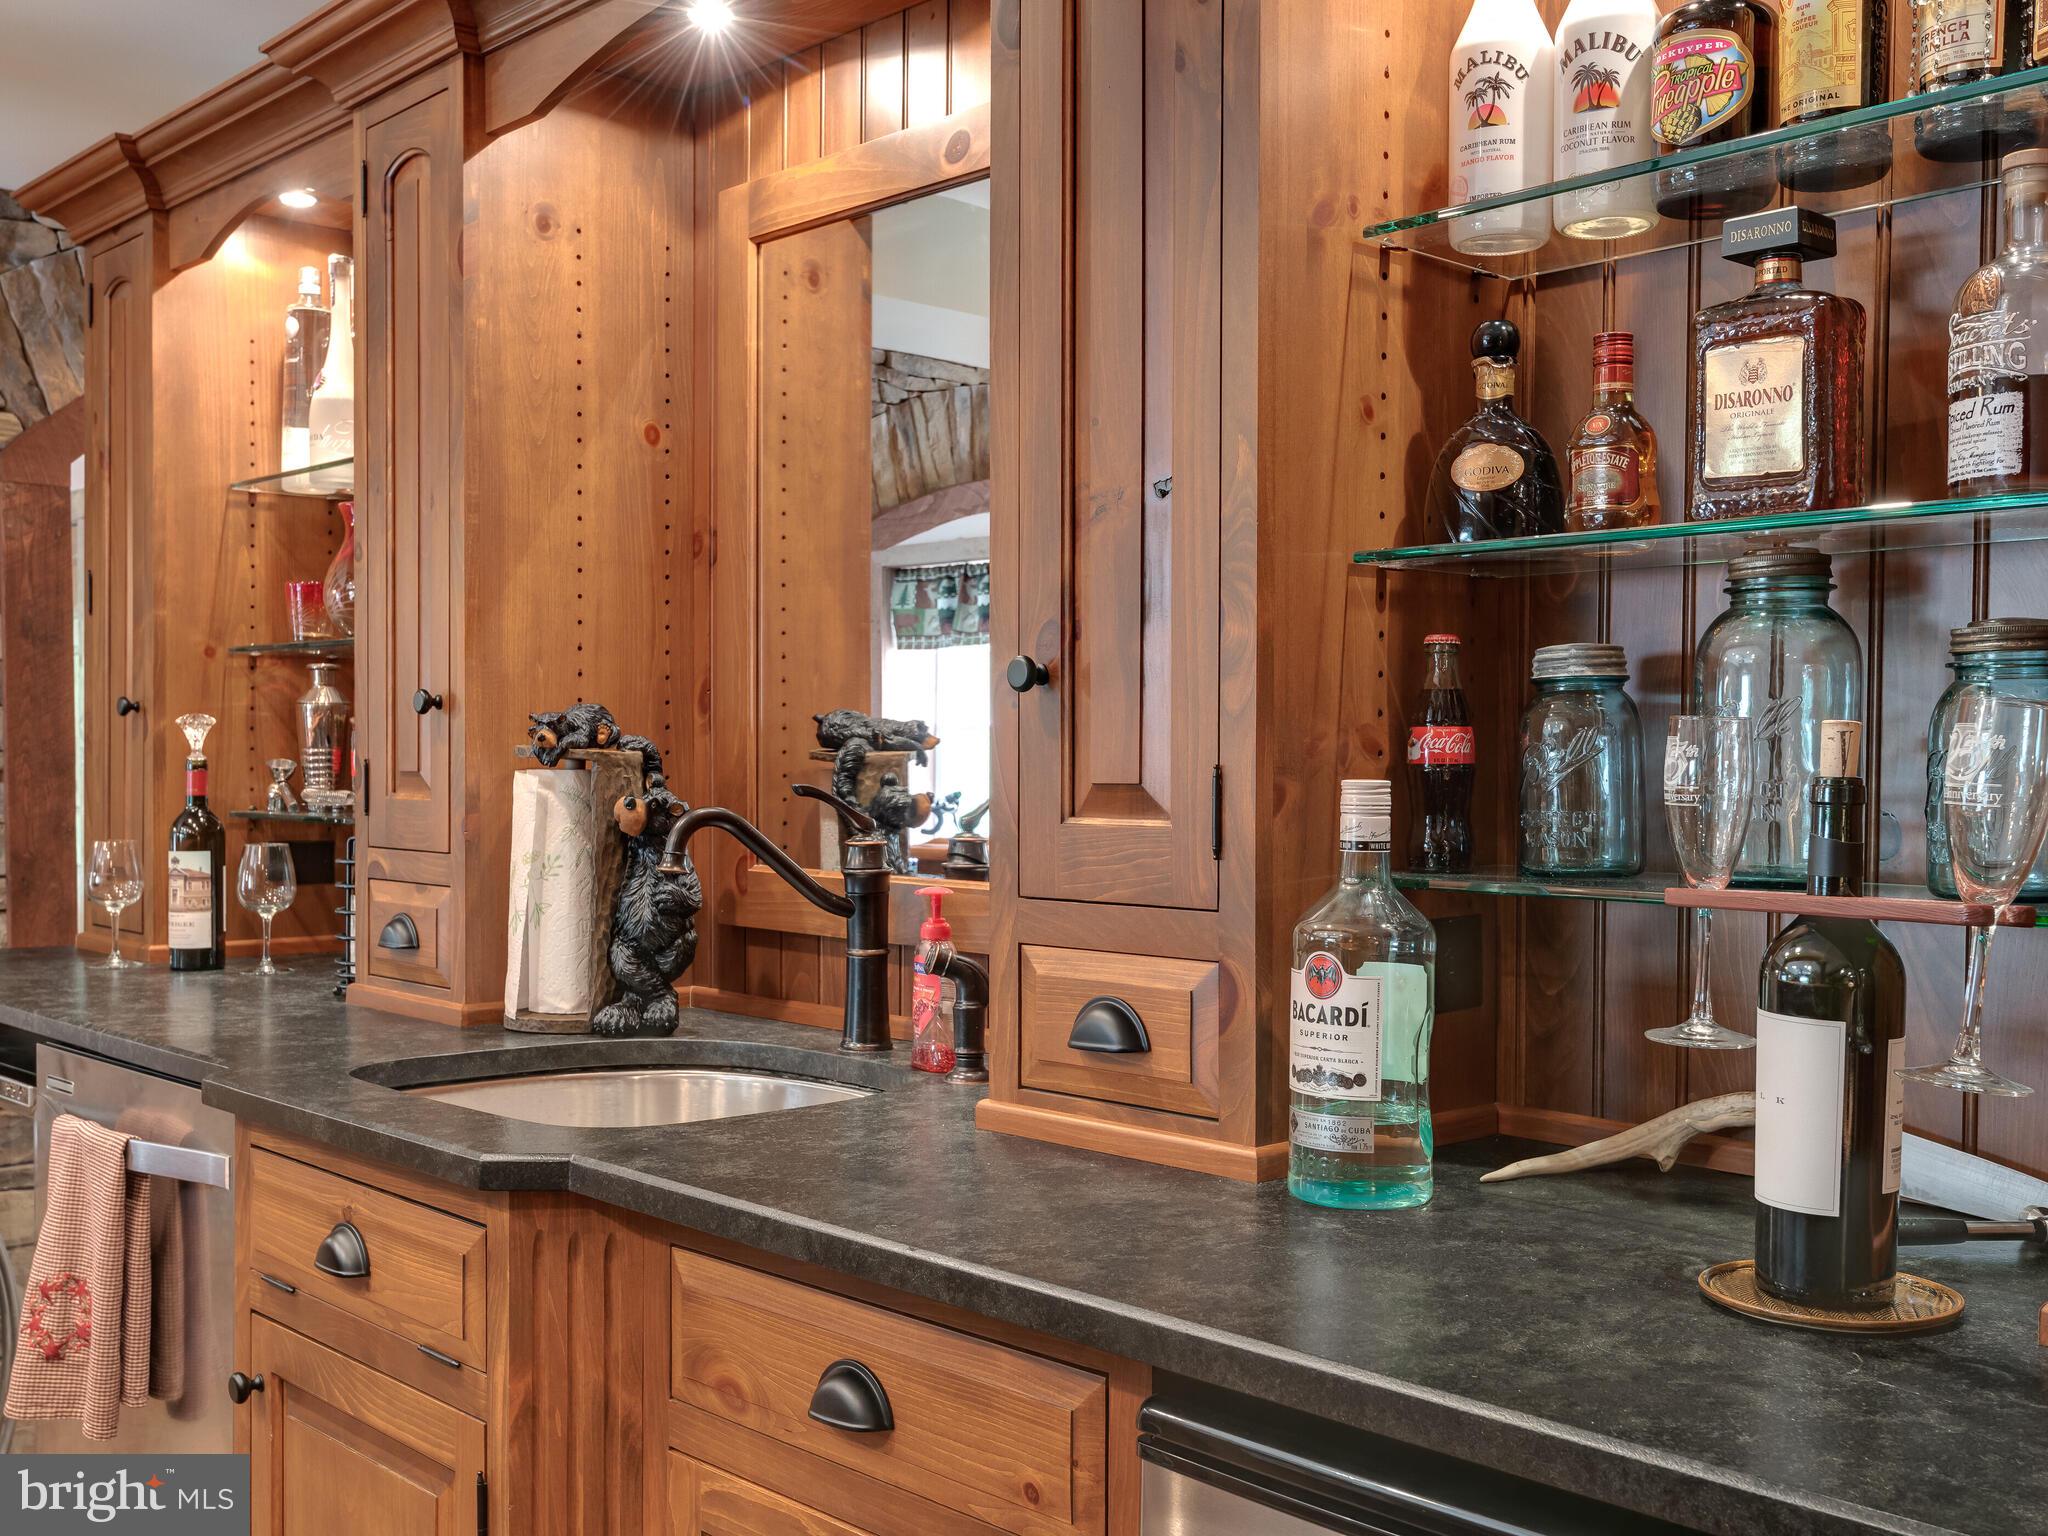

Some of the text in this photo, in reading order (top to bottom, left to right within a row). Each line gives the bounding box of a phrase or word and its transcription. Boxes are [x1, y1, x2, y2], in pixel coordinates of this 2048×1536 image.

[1790, 20, 1818, 34] LIQUEUR
[1791, 15, 1817, 27] COFFEE
[1921, 20, 1970, 46] FRENCH
[1555, 31, 1643, 74] MALIBU
[1920, 31, 1971, 57] VANLLA
[1454, 50, 1530, 91] MALIBU
[1670, 63, 1714, 87] TROPICAL
[1652, 57, 1736, 122] Pineapple
[1792, 92, 1840, 108] ORIGINAL
[1611, 120, 1632, 129] RUM
[1561, 137, 1597, 154] COCONUT
[1601, 135, 1636, 144] FLAVOR
[1461, 154, 1515, 168] MANGO FLAVOR
[1730, 220, 1792, 243] DISARONNO
[1713, 384, 1794, 411] DISARONNO
[1729, 407, 1776, 419] ORIGINALE
[1948, 396, 2016, 425] piced Rum
[1602, 452, 1630, 469] ESTATE
[1464, 466, 1510, 478] GODIVA
[1419, 728, 1473, 754] Coca-Cola
[1293, 1000, 1369, 1028] BACARDÍ
[1300, 1029, 1348, 1041] SUPERIOR
[1304, 1121, 1340, 1133] SANTIAGO
[1347, 1127, 1371, 1135] CUBA
